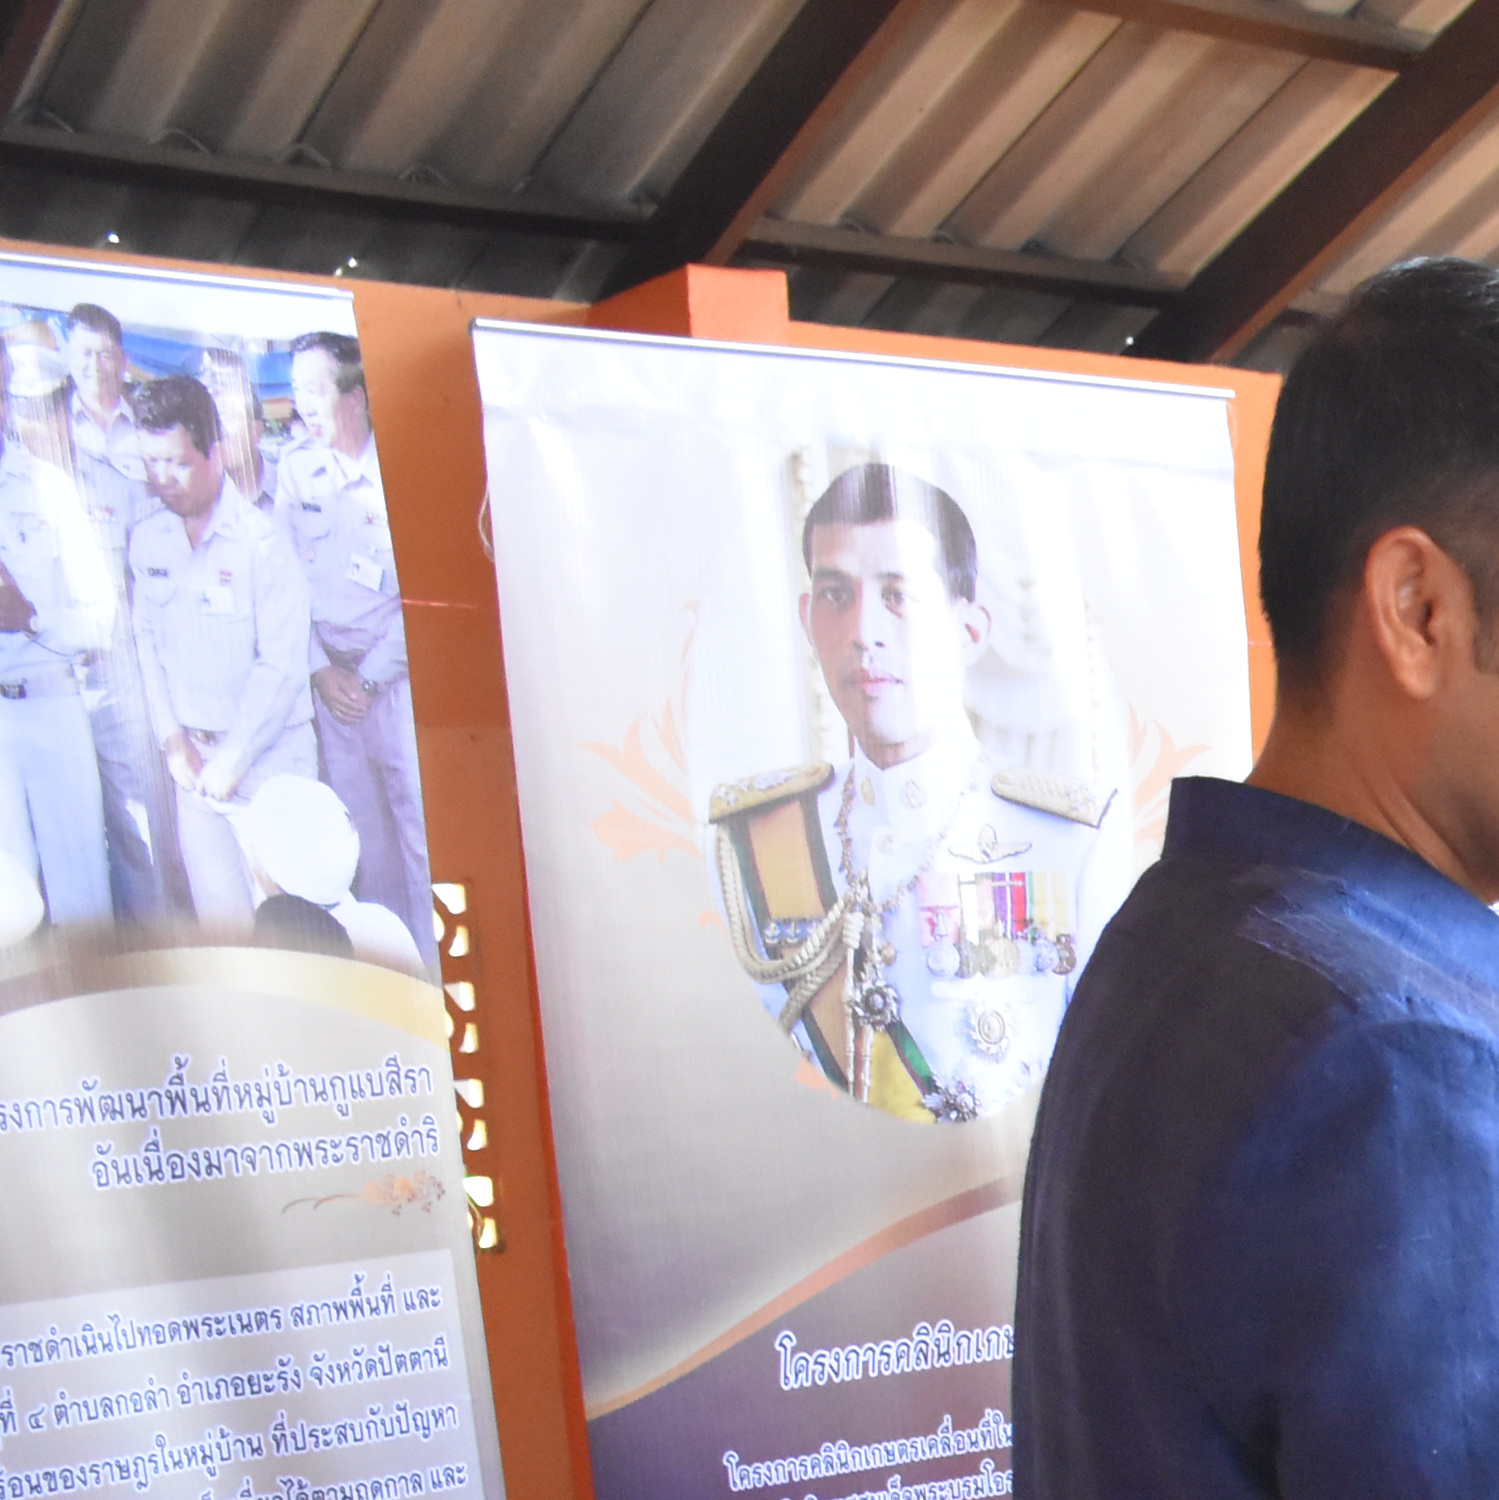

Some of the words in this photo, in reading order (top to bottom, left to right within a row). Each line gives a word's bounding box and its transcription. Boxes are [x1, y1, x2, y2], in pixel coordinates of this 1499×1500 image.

[93, 1115, 439, 1188] อันเนื่องมาจากพระราชดำริ
[290, 1273, 396, 1328] สภาพพื้นที่
[403, 1288, 441, 1312] และ
[28, 1406, 45, 1430] ๔
[54, 1377, 170, 1426] ตำบลกอลำ
[177, 1356, 302, 1405] อำเภอยะรัง
[310, 1334, 449, 1387] จังหวัดปัตตานี
[271, 1402, 458, 1454] ที่ประสบกับปัญหา
[430, 1465, 467, 1490] และ
